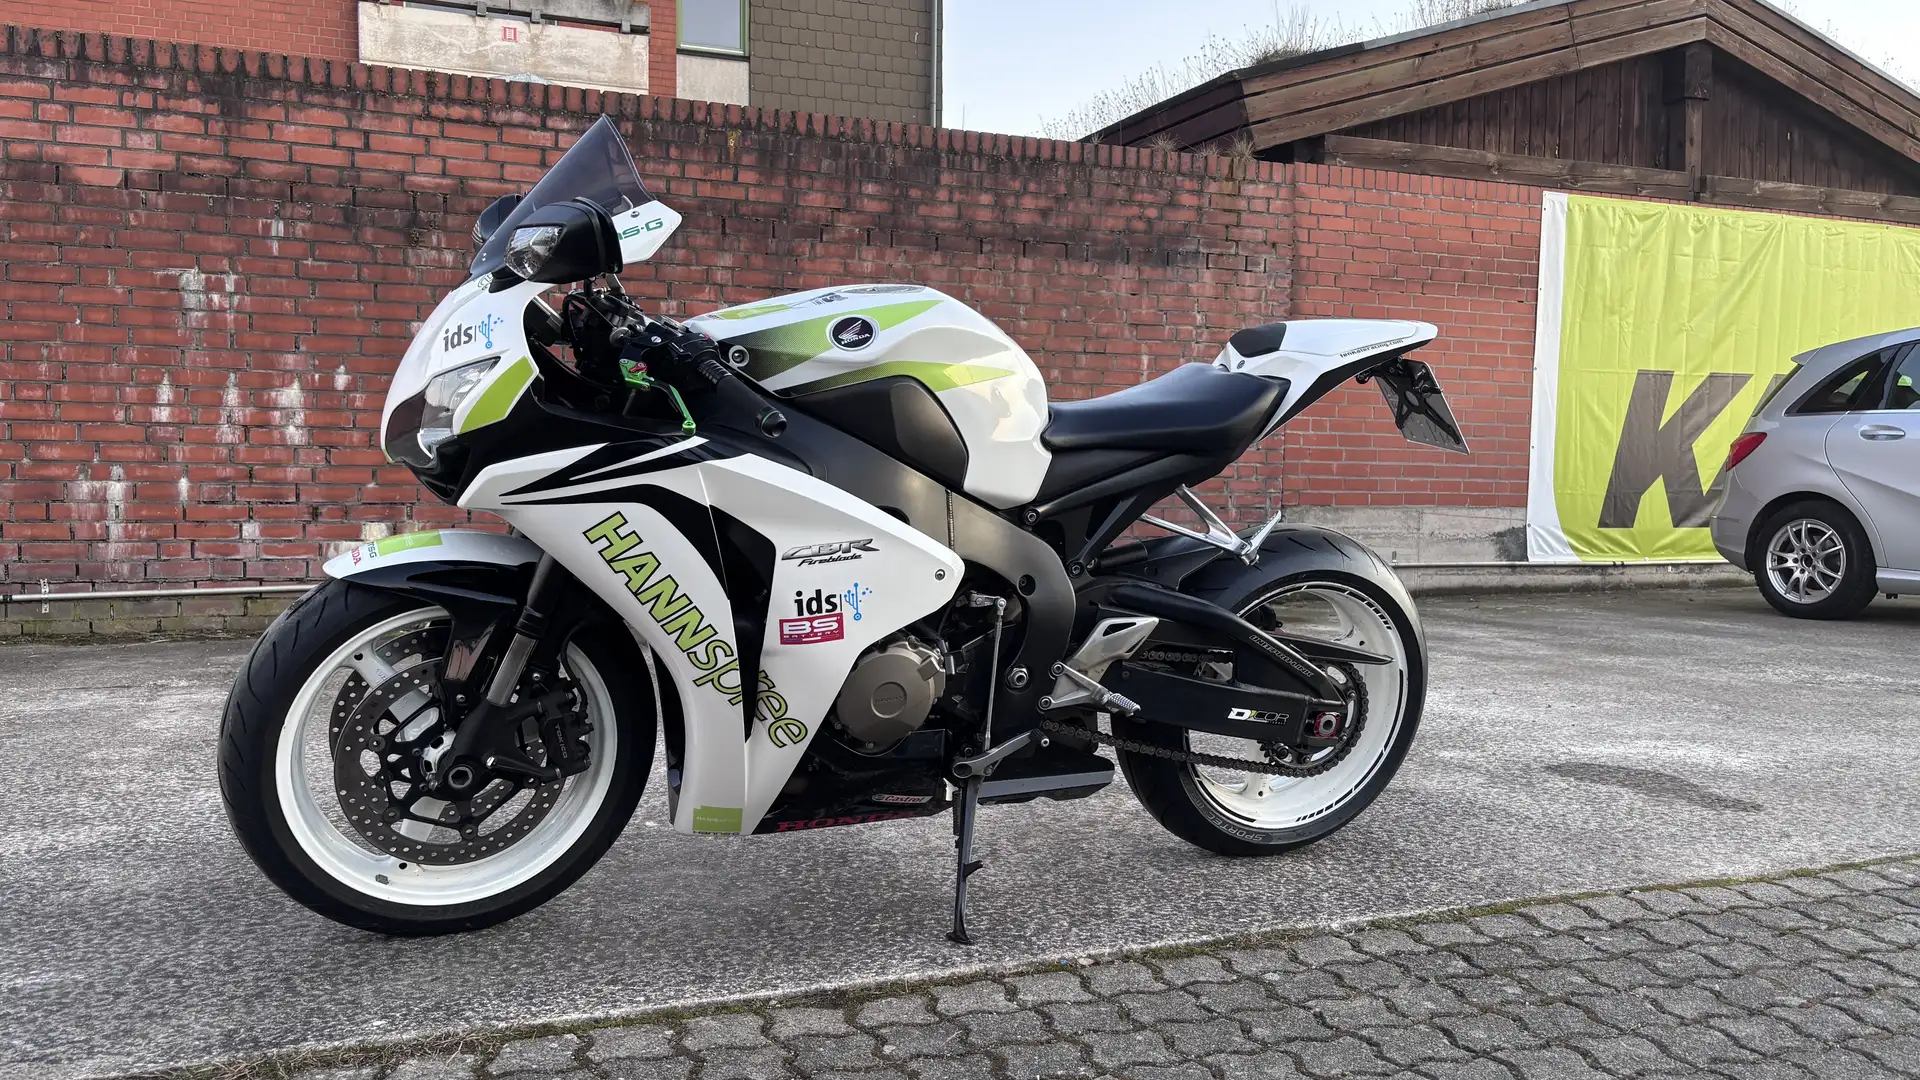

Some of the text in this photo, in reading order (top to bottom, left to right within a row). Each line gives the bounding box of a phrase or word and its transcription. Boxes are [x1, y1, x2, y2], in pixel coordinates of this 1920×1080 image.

[443, 323, 473, 352] ids
[841, 333, 871, 345] HONDA
[1598, 369, 1798, 528] K
[781, 538, 880, 561] CBR
[797, 553, 863, 567] Fireblade
[794, 588, 838, 617] ids
[783, 617, 839, 635] BS
[555, 724, 568, 759] TOKICO
[884, 794, 925, 803] Castrol
[775, 810, 921, 833] HONDA
[1207, 810, 1266, 841] SPORTEC
